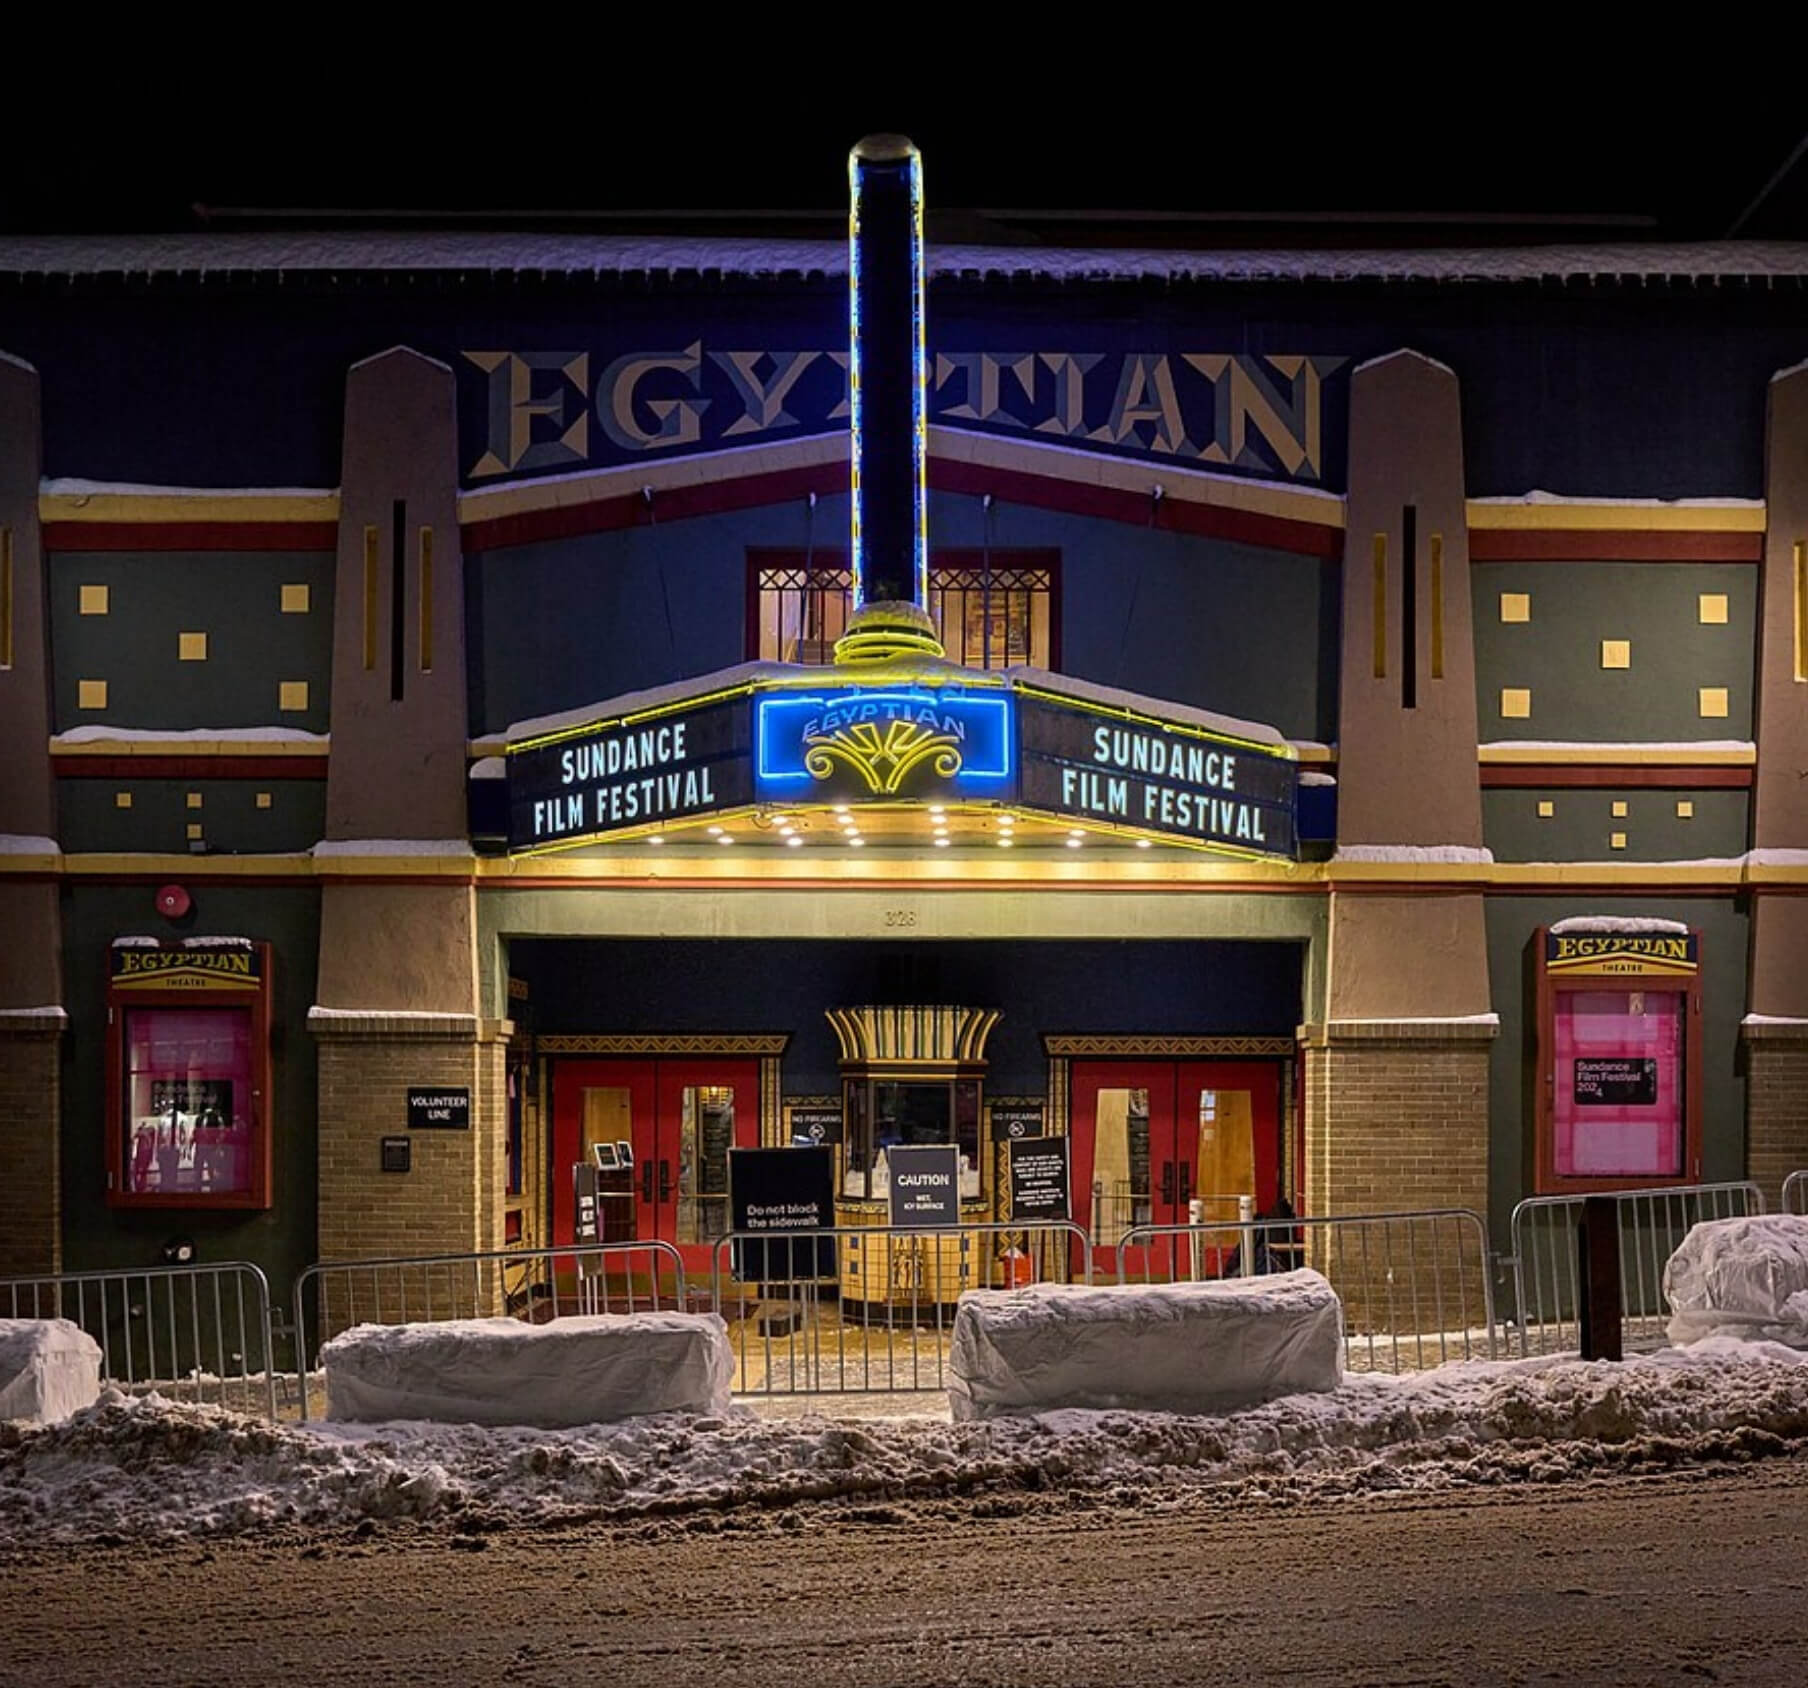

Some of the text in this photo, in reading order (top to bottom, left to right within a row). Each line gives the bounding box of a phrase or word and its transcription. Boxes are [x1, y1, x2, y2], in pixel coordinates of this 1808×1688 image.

[802, 703, 965, 741] EGYPTIAN
[561, 722, 686, 785] SUNDANCE
[1093, 726, 1237, 791] SUNDANCE
[534, 766, 715, 836] FILM FESTIVAL
[1062, 768, 1266, 842] FILM FESTIVAL
[1556, 938, 1688, 959] EGYPTIAN
[121, 952, 249, 973] EGYPTIAN
[1602, 964, 1643, 973] THEATRE
[166, 978, 206, 987] THEATRE
[1577, 1061, 1630, 1071] Sundance
[1577, 1072, 1641, 1081] Film Festival
[411, 1096, 467, 1107] VOLUNTEER
[427, 1108, 450, 1120] LINE
[898, 1174, 950, 1187] CAUTION
[747, 1202, 819, 1216] Do not block
[747, 1215, 819, 1228] the sidewalk
